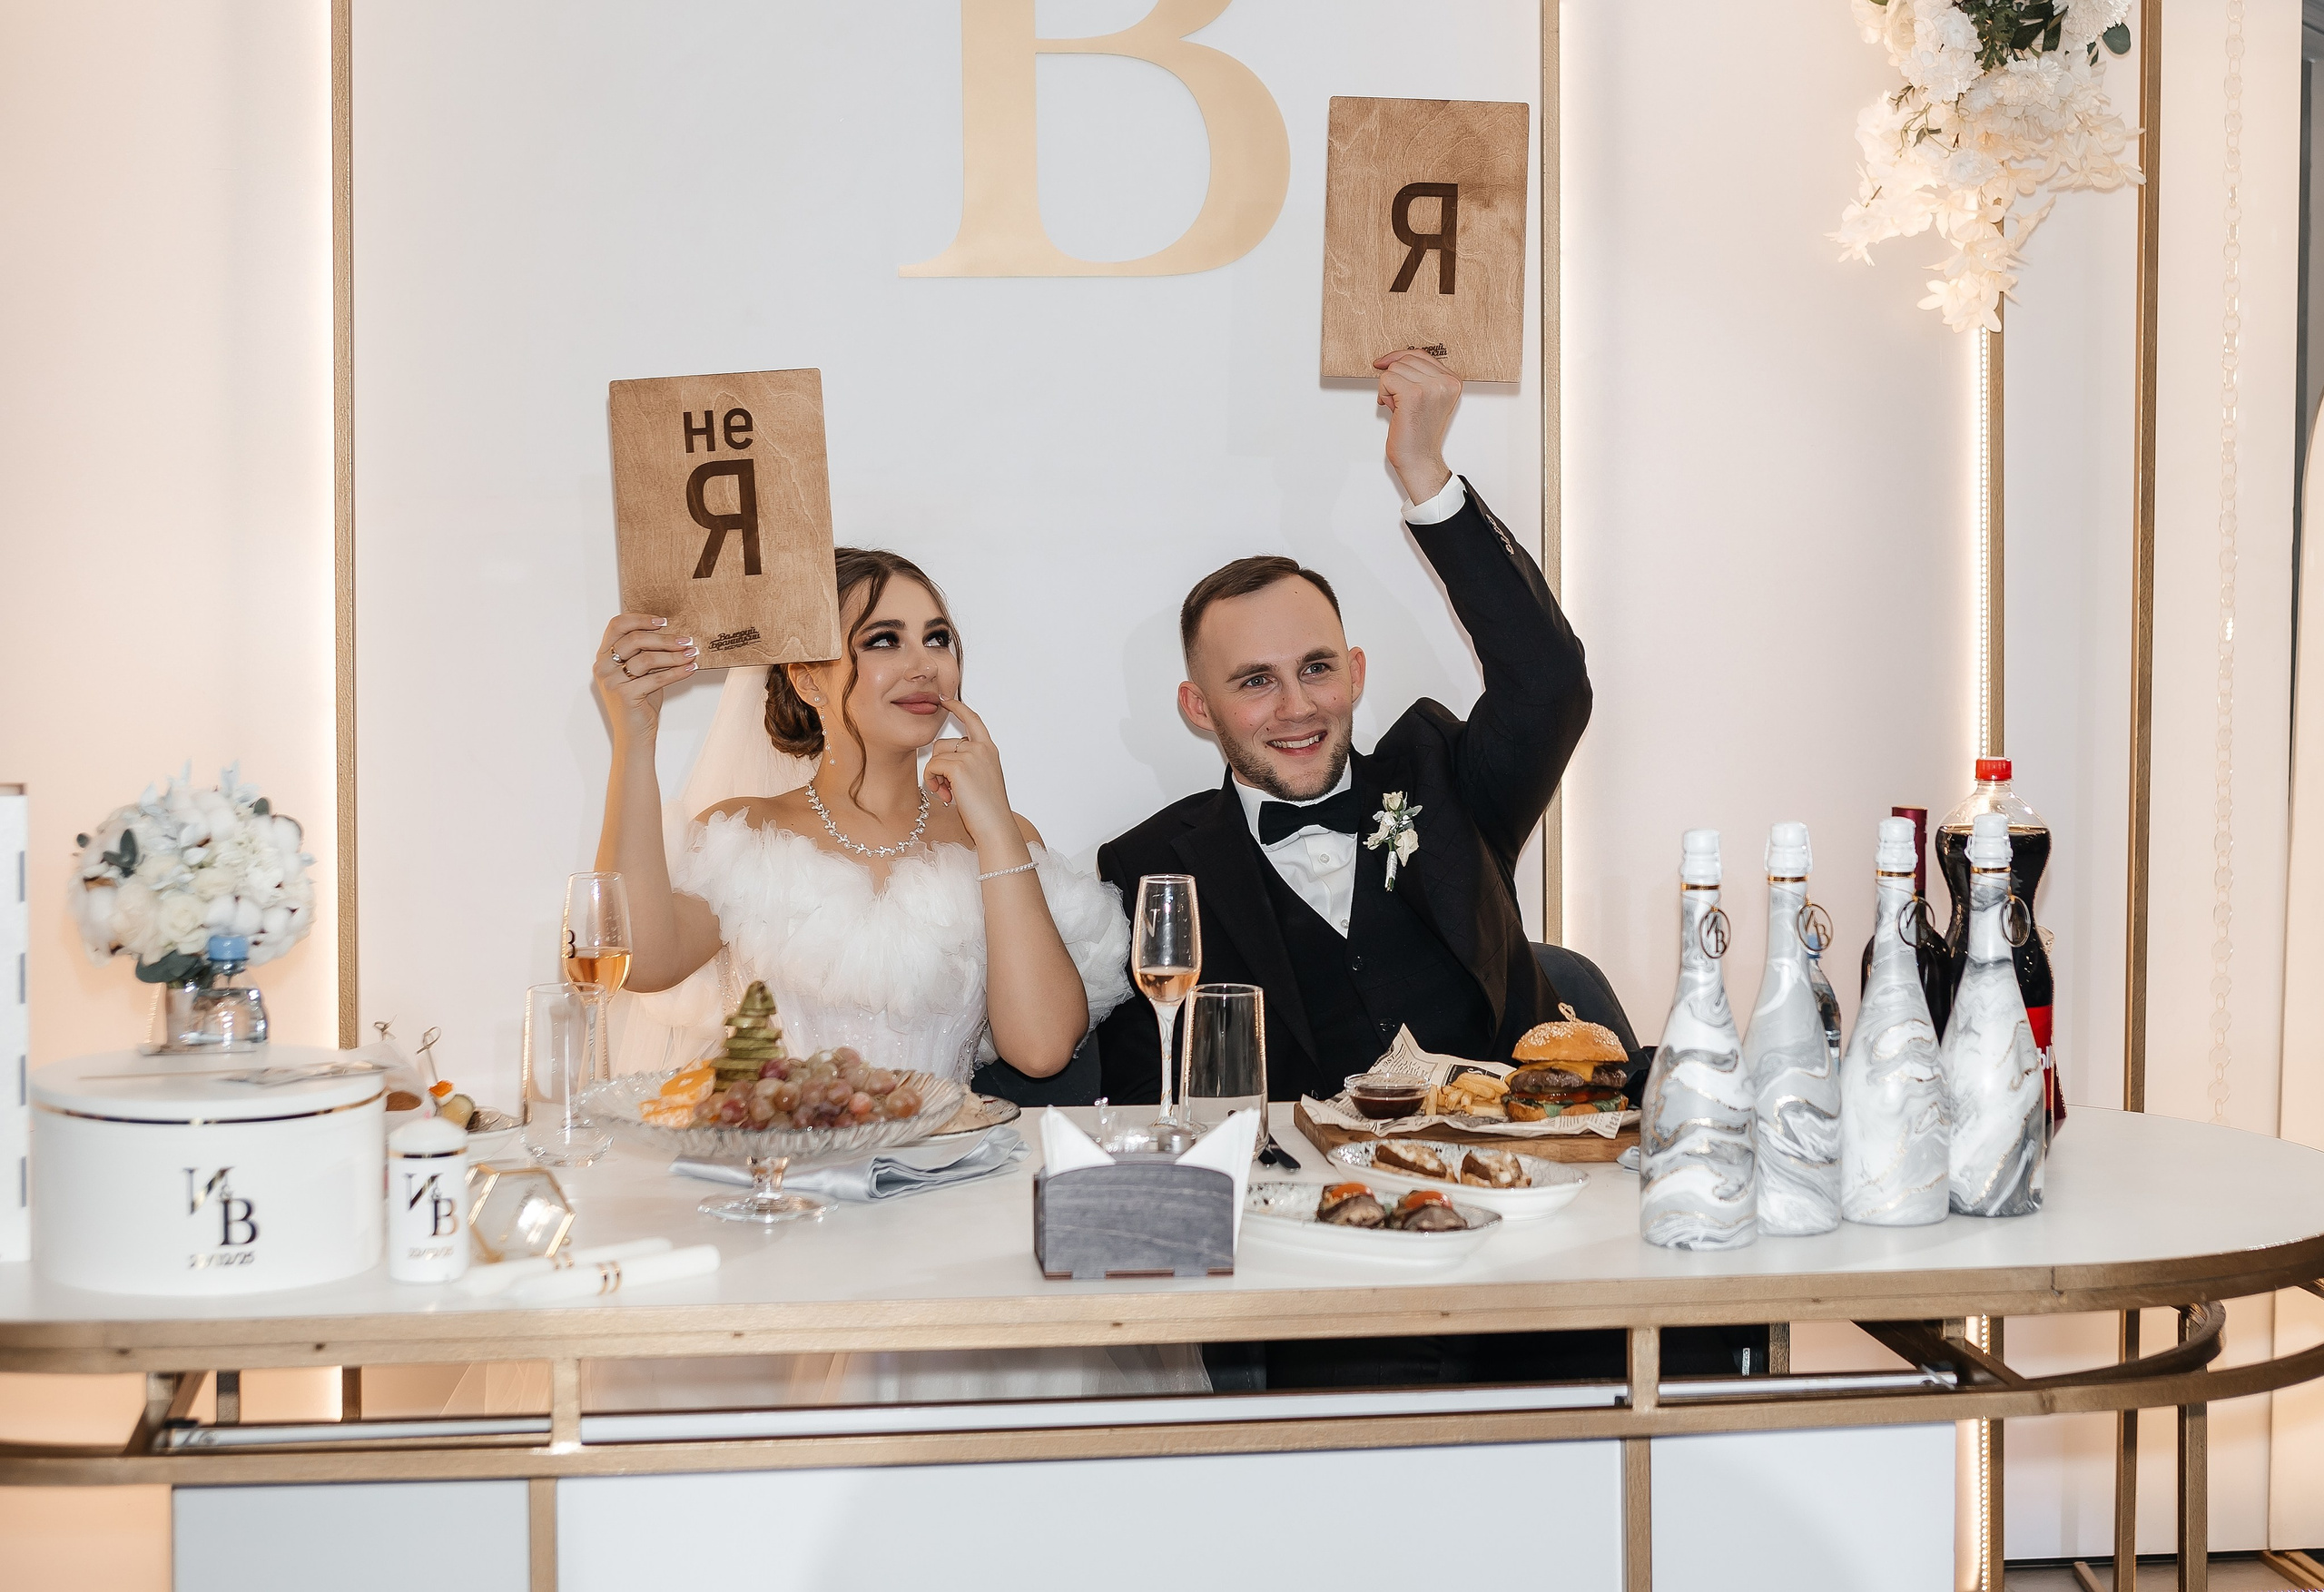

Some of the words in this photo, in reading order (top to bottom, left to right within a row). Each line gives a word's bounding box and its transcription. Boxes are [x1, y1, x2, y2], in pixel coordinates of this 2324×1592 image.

[1388, 182, 1459, 295] Я
[683, 408, 754, 453] не
[685, 458, 763, 579] Я
